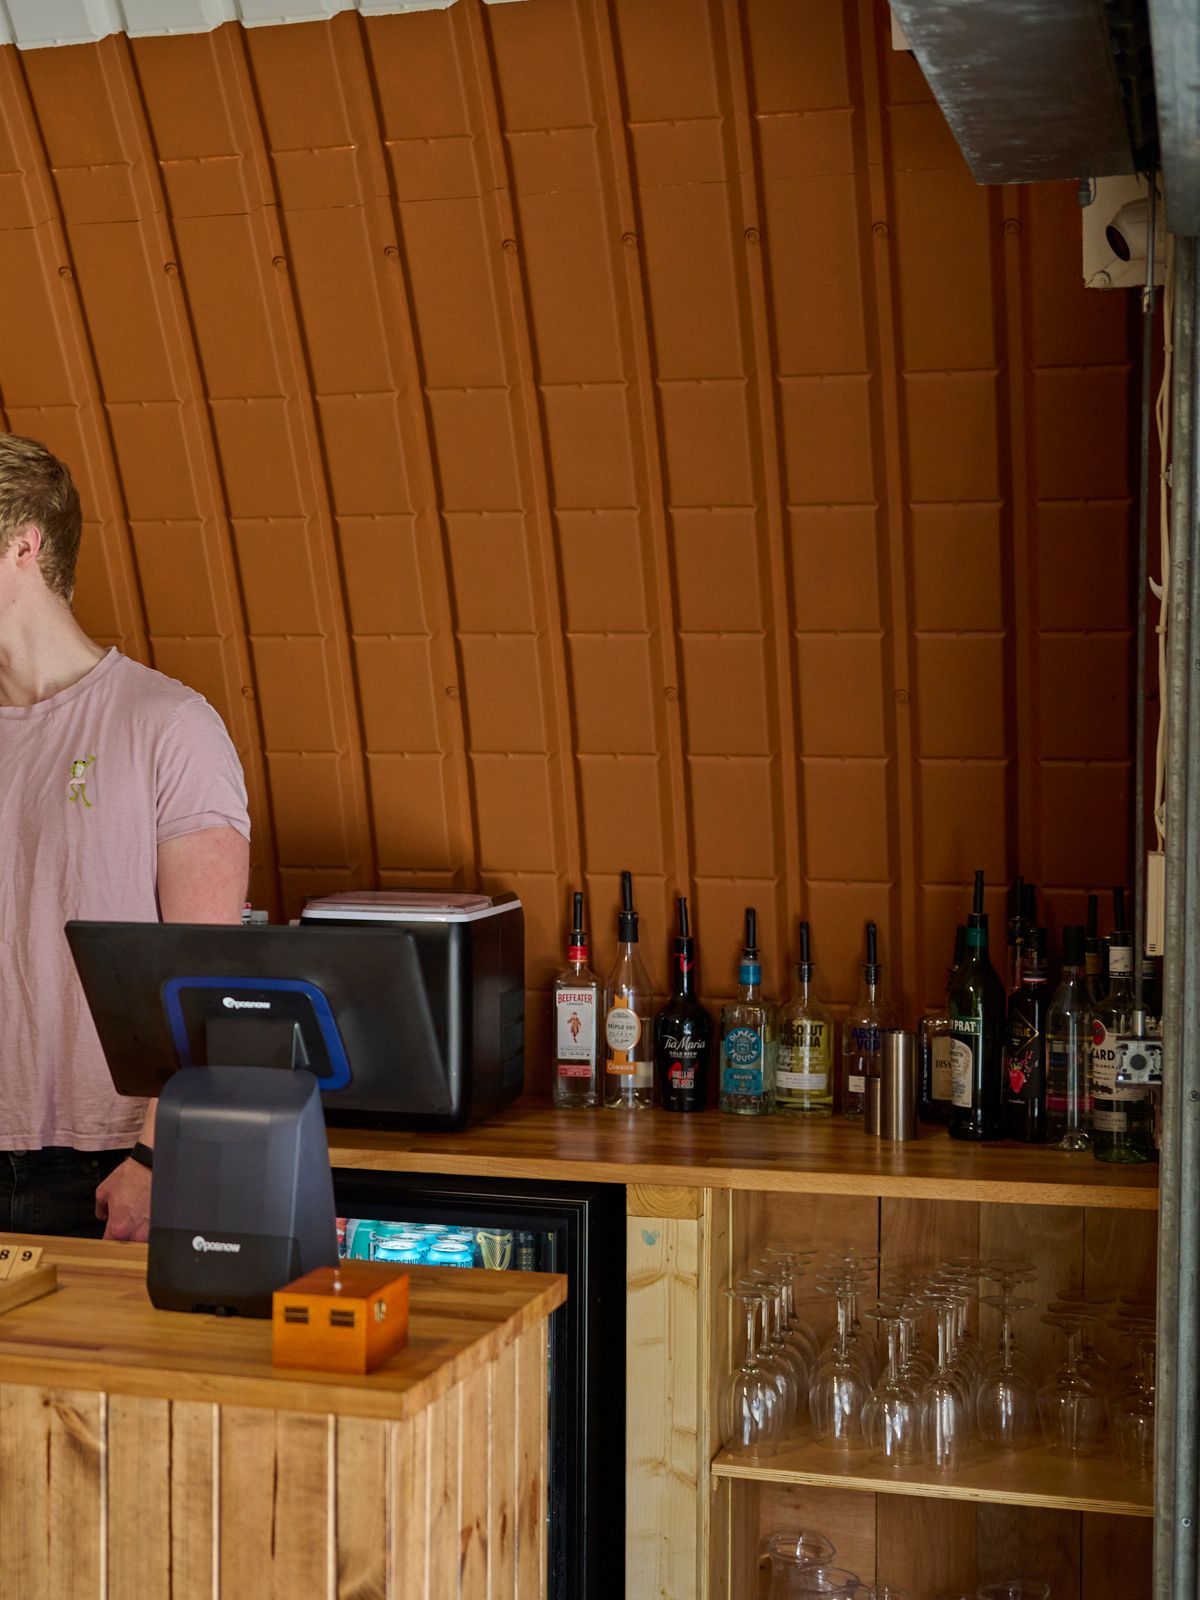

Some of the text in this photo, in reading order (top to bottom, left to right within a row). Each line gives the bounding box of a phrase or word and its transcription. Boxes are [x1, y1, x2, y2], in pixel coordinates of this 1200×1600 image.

[557, 993, 593, 1005] BEEFEATER
[954, 1020, 976, 1033] PRAT
[662, 1034, 705, 1050] Tia Maria
[729, 1030, 757, 1043] OLMECA
[729, 1048, 759, 1062] TEQUILA
[21, 1250, 32, 1262] 9
